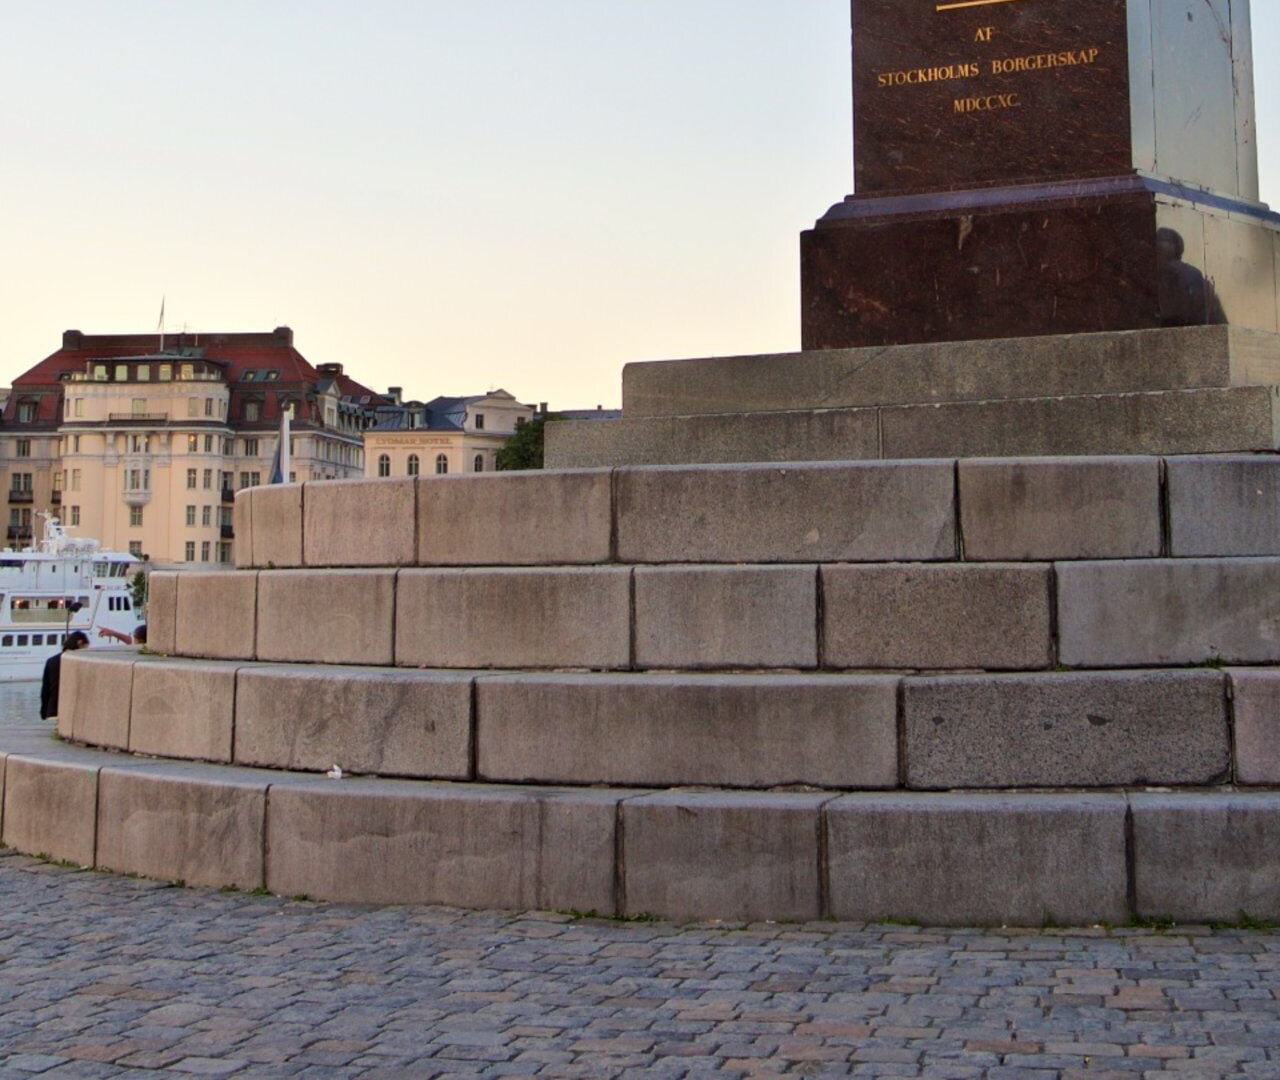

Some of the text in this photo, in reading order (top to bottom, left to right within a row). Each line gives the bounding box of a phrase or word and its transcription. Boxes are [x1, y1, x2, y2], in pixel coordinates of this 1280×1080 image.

[974, 27, 995, 42] AF
[877, 48, 1099, 88] STOCKHOLMS BORGERSKAP
